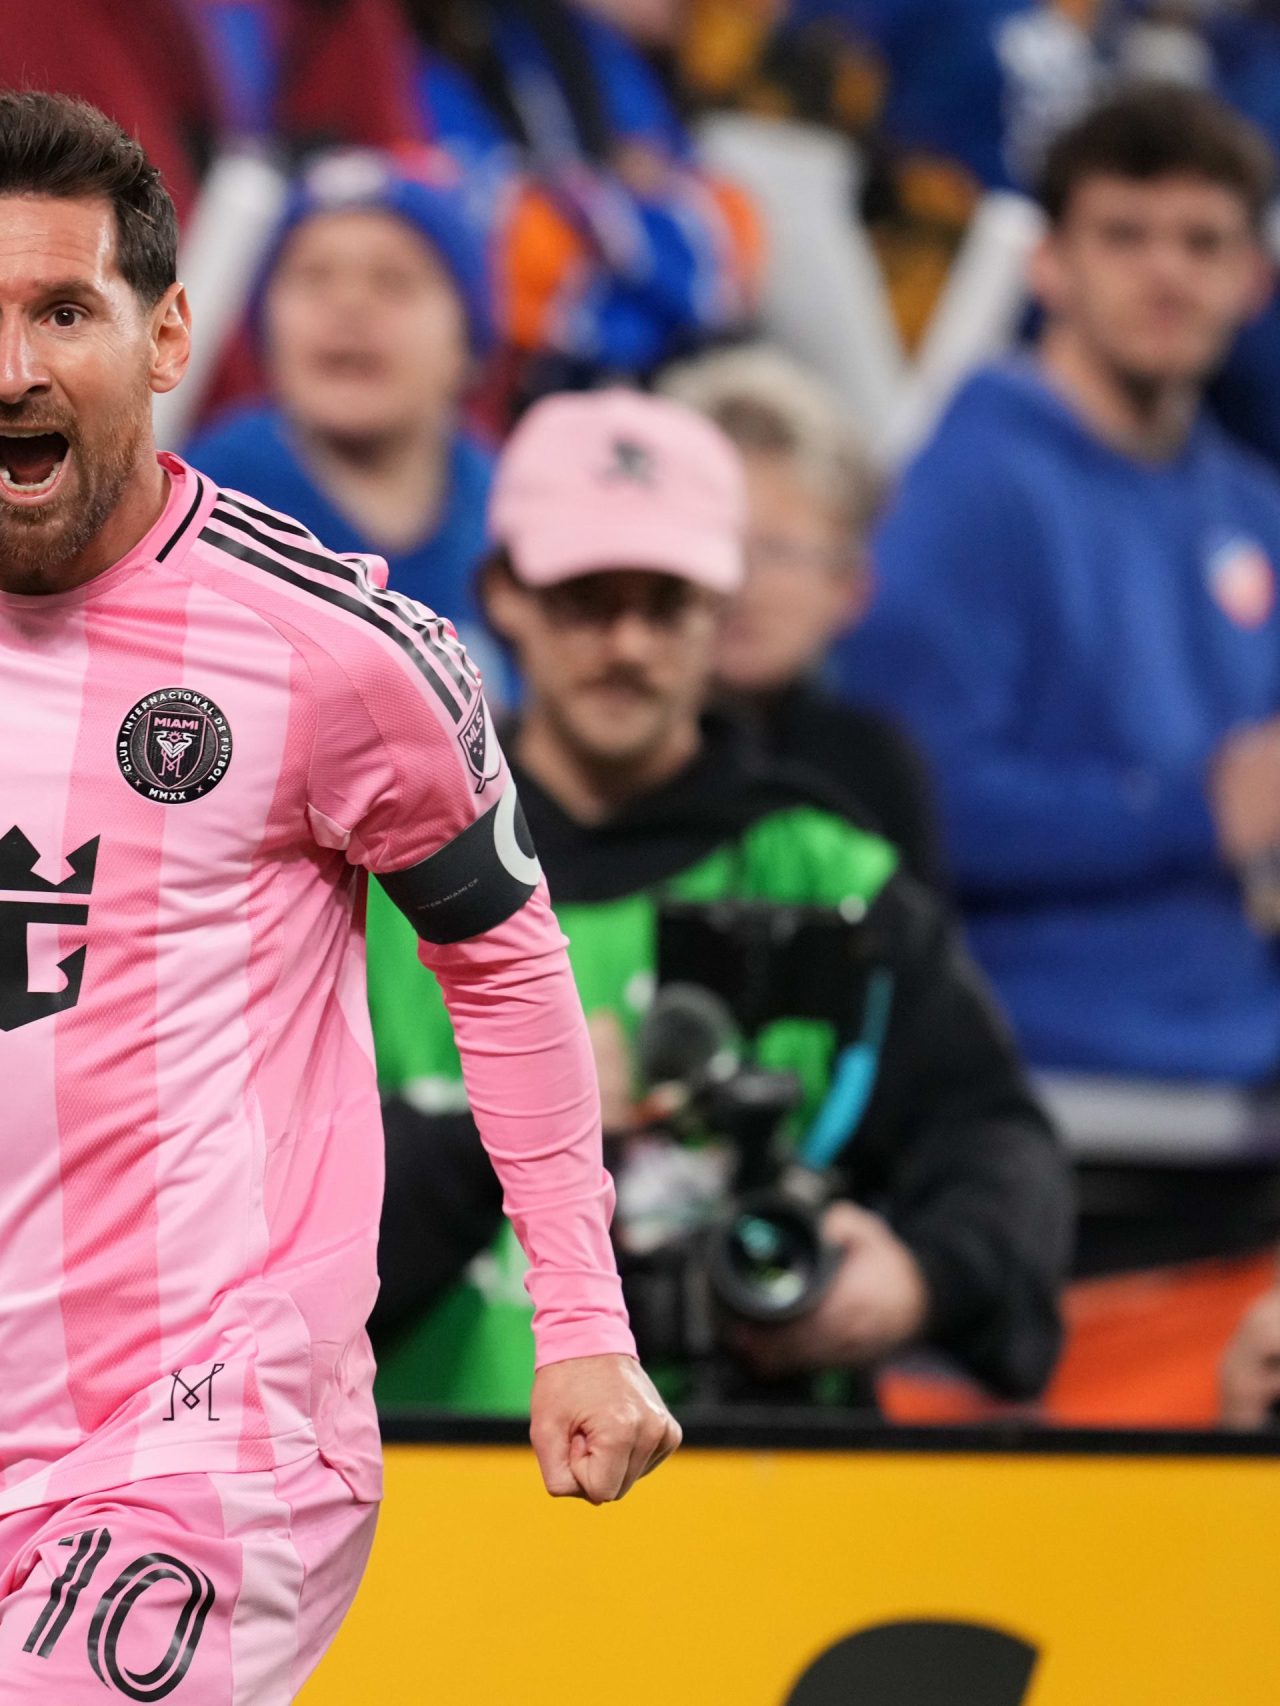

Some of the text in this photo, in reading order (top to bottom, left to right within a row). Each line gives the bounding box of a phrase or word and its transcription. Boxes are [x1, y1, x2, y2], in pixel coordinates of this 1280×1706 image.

[122, 691, 215, 735] INTERNACIONAL
[154, 717, 199, 730] MIAMI
[214, 717, 227, 732] DE
[465, 711, 483, 748] MLS
[119, 741, 132, 772] CLUB
[149, 788, 186, 800] MMXX
[22, 1528, 215, 1702] 10
